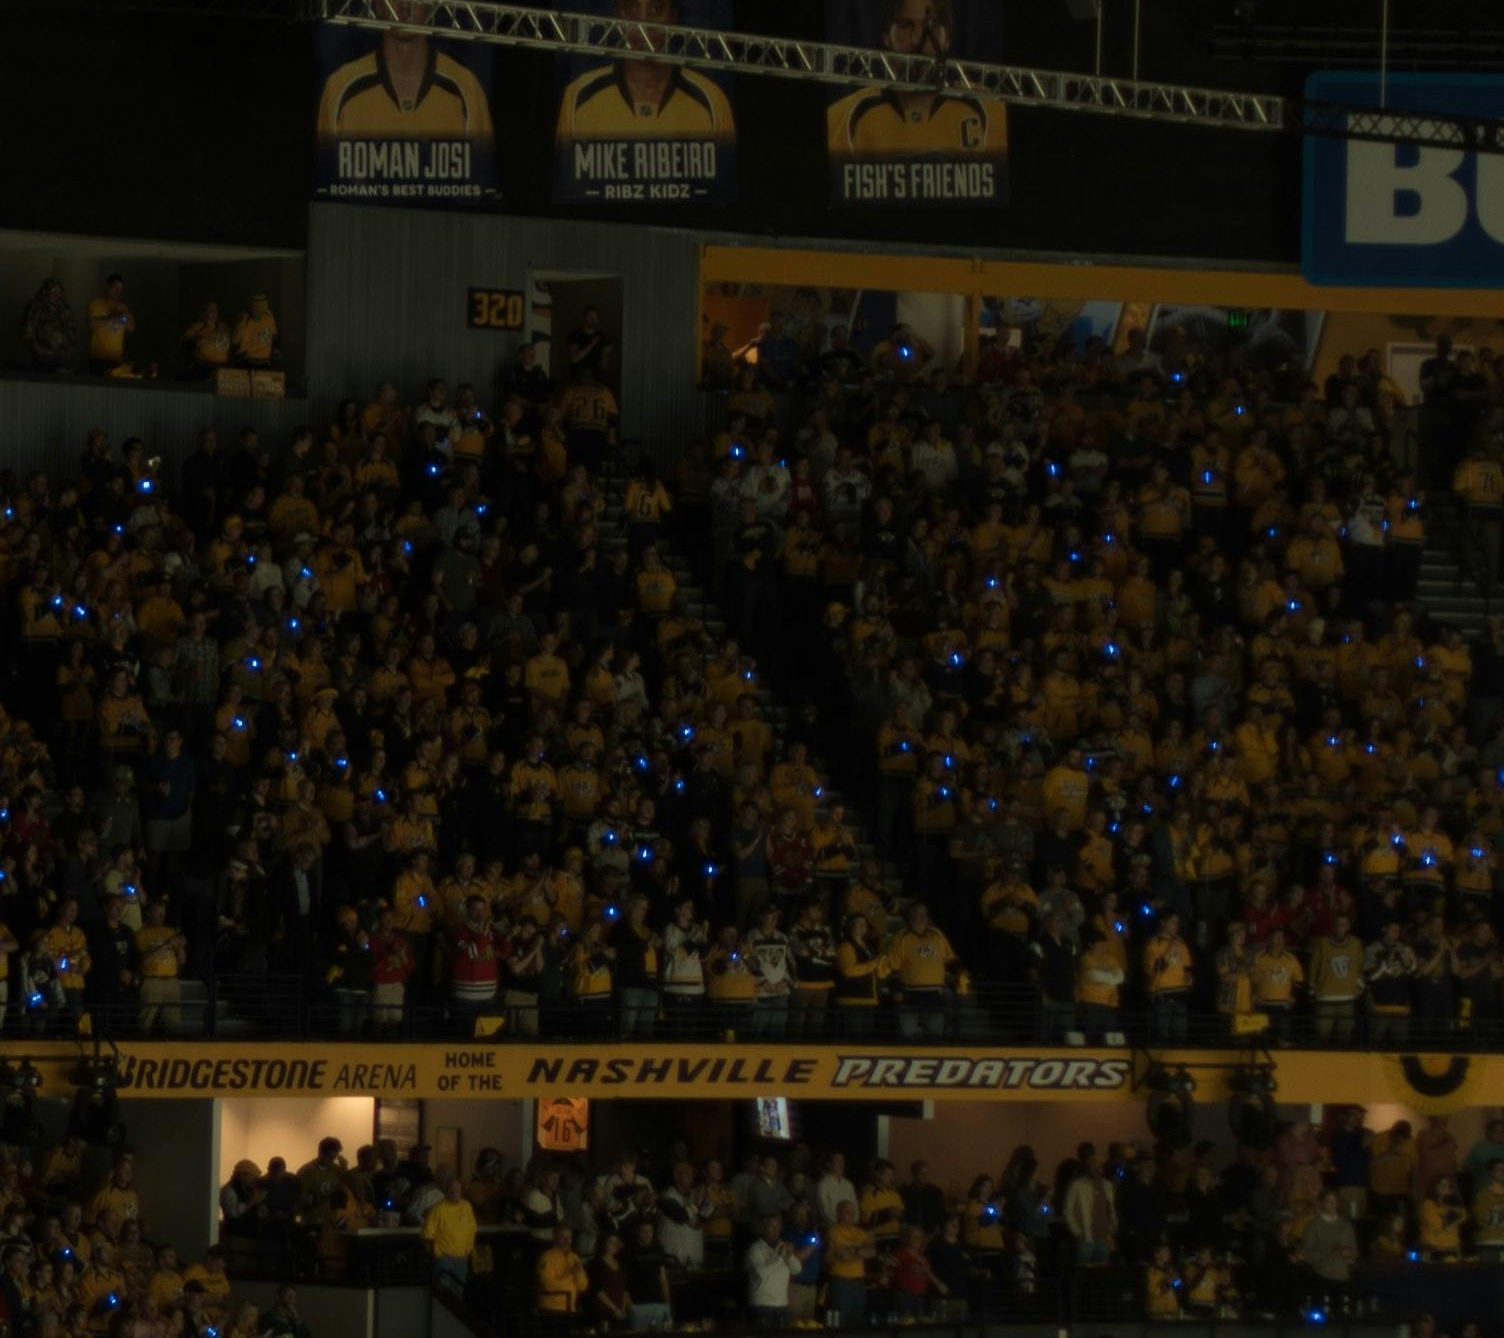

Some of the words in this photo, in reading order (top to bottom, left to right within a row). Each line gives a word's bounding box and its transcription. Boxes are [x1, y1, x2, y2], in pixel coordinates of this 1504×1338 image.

[960, 117, 981, 149] C
[338, 140, 420, 179] ROMAN
[423, 140, 471, 180] JOSI
[573, 139, 630, 180] MIKE
[633, 140, 717, 180] RIBEIRO
[330, 183, 390, 198] ROMAN'S
[392, 184, 425, 198] BEST
[426, 184, 482, 198] BUDDIES
[604, 183, 645, 200] RIBZ
[649, 182, 691, 199] KIDZ
[843, 162, 908, 200] FISH'S
[910, 161, 995, 199] FRIENDS
[472, 290, 524, 326] 320
[118, 1054, 329, 1091] BRIDGESTONE
[333, 1063, 418, 1089] ARENA
[445, 1052, 496, 1068] HOME
[525, 1057, 819, 1085] NASHVILLE
[832, 1056, 1135, 1089] PREDATORS
[438, 1074, 460, 1091] OF
[468, 1074, 503, 1091] THE
